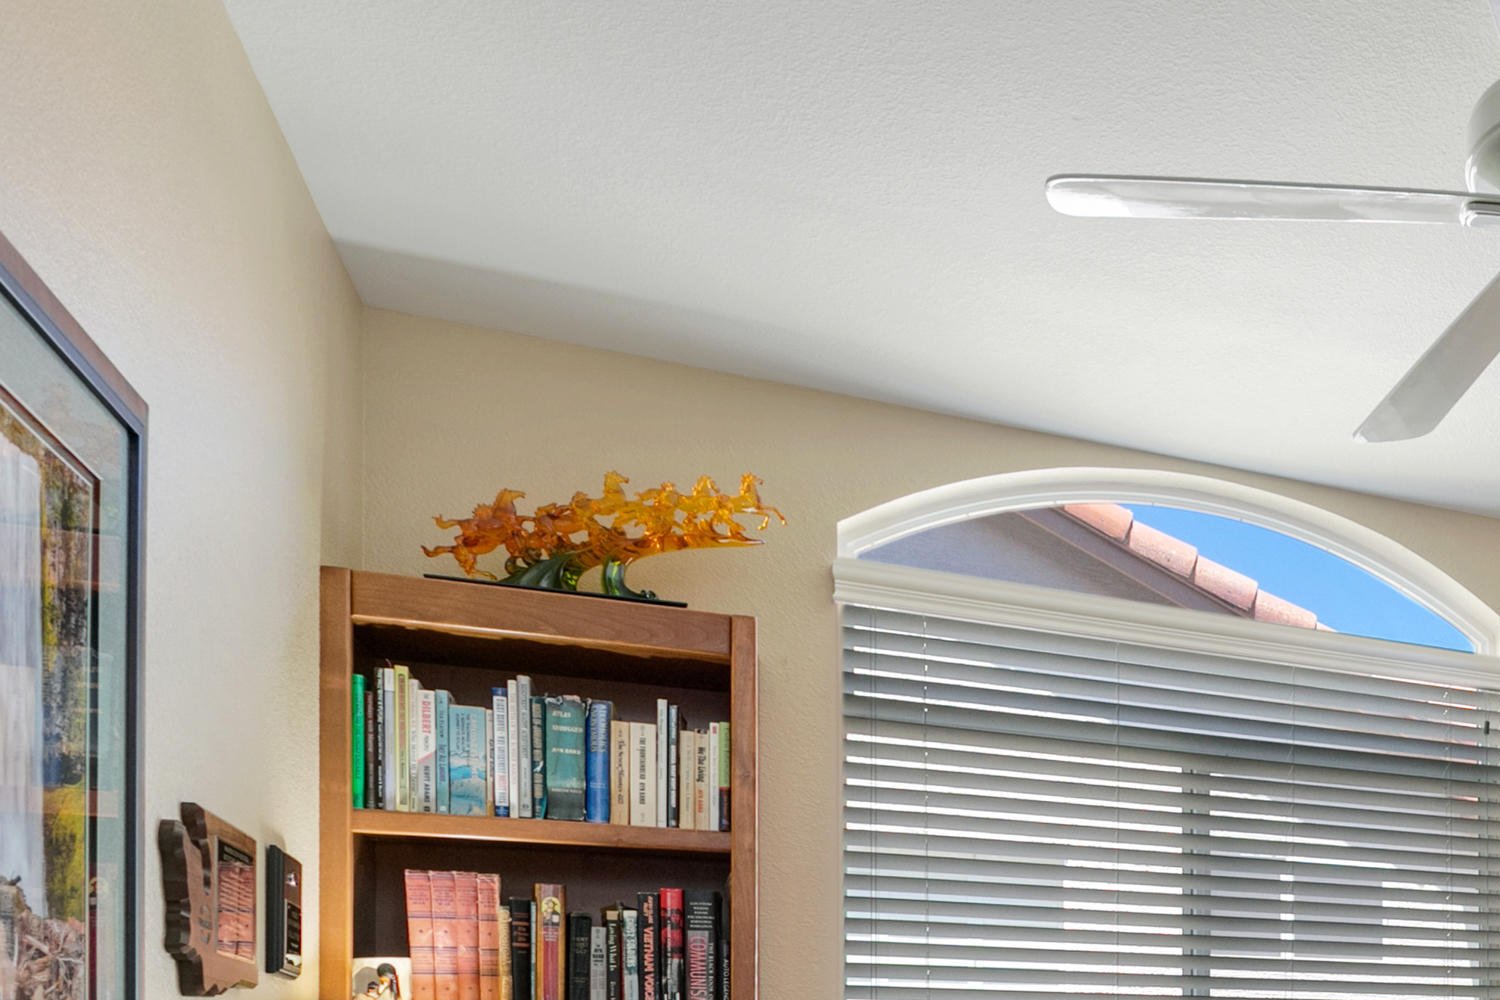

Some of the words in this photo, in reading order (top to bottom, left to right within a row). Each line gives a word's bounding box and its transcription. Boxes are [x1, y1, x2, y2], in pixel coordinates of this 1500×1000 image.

[421, 701, 431, 734] DILBERT
[608, 923, 616, 945] Loving
[609, 946, 617, 963] What
[643, 927, 654, 971] VIETNAM
